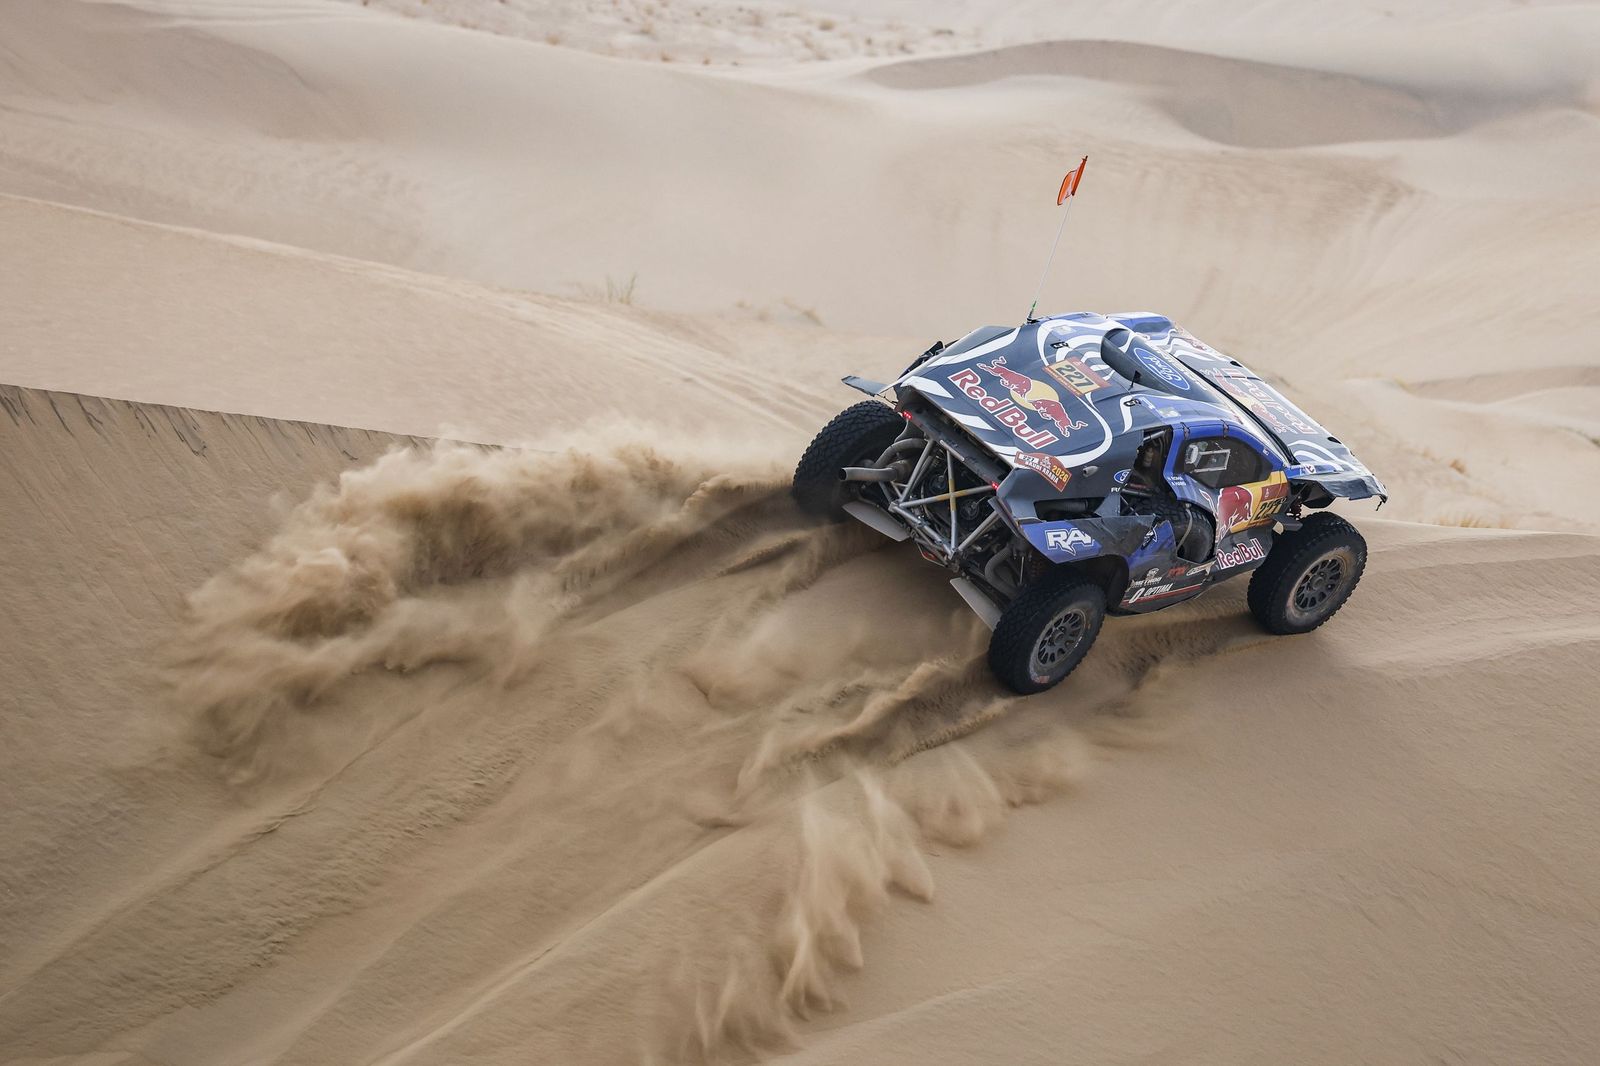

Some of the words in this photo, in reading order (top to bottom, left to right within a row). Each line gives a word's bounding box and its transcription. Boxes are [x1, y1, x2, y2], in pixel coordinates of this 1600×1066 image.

[1056, 364, 1095, 388] 227
[1142, 354, 1182, 381] Ford
[1024, 461, 1042, 471] SAUDI
[1041, 467, 1060, 484] ARABIA
[1051, 464, 1069, 483] 2026
[1237, 537, 1266, 562] Bull
